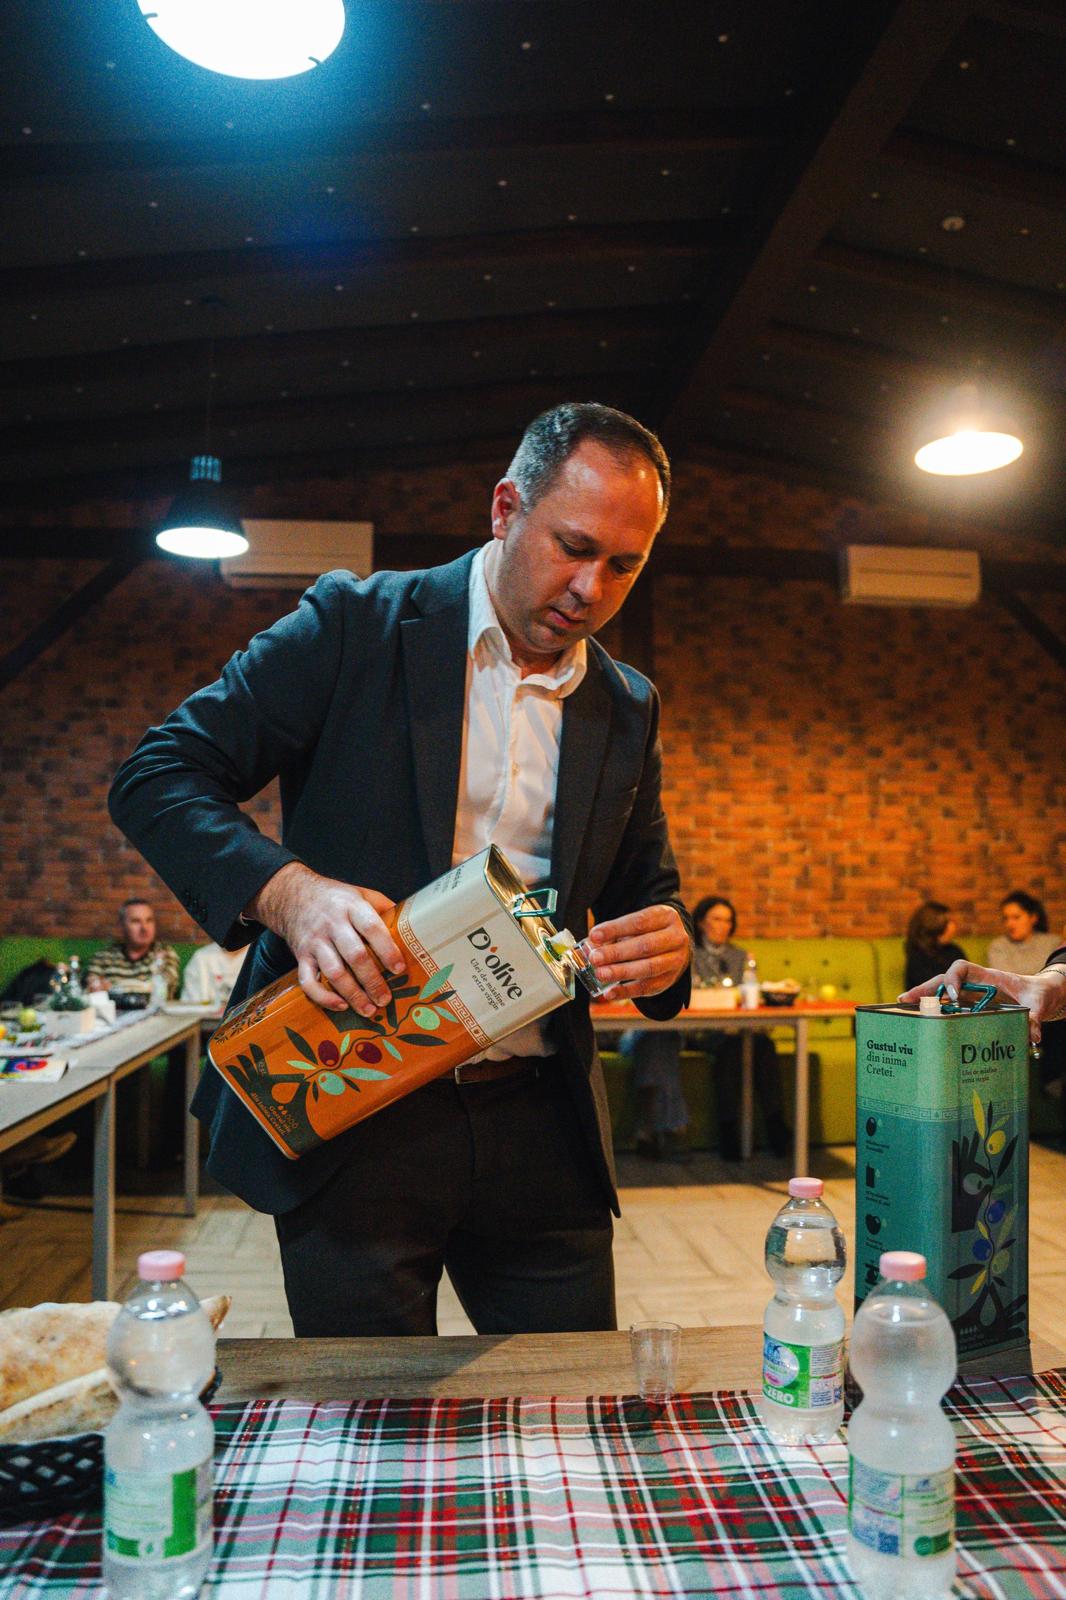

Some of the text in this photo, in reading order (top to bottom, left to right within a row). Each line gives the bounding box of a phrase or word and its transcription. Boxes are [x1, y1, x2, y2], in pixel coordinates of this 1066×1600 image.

[470, 958, 484, 973] Ulei
[480, 973, 488, 982] de
[472, 974, 499, 1011] extra virgin
[866, 1040, 913, 1055] Gustul viu
[866, 1051, 907, 1068] din inima
[866, 1063, 896, 1078] Cretei.
